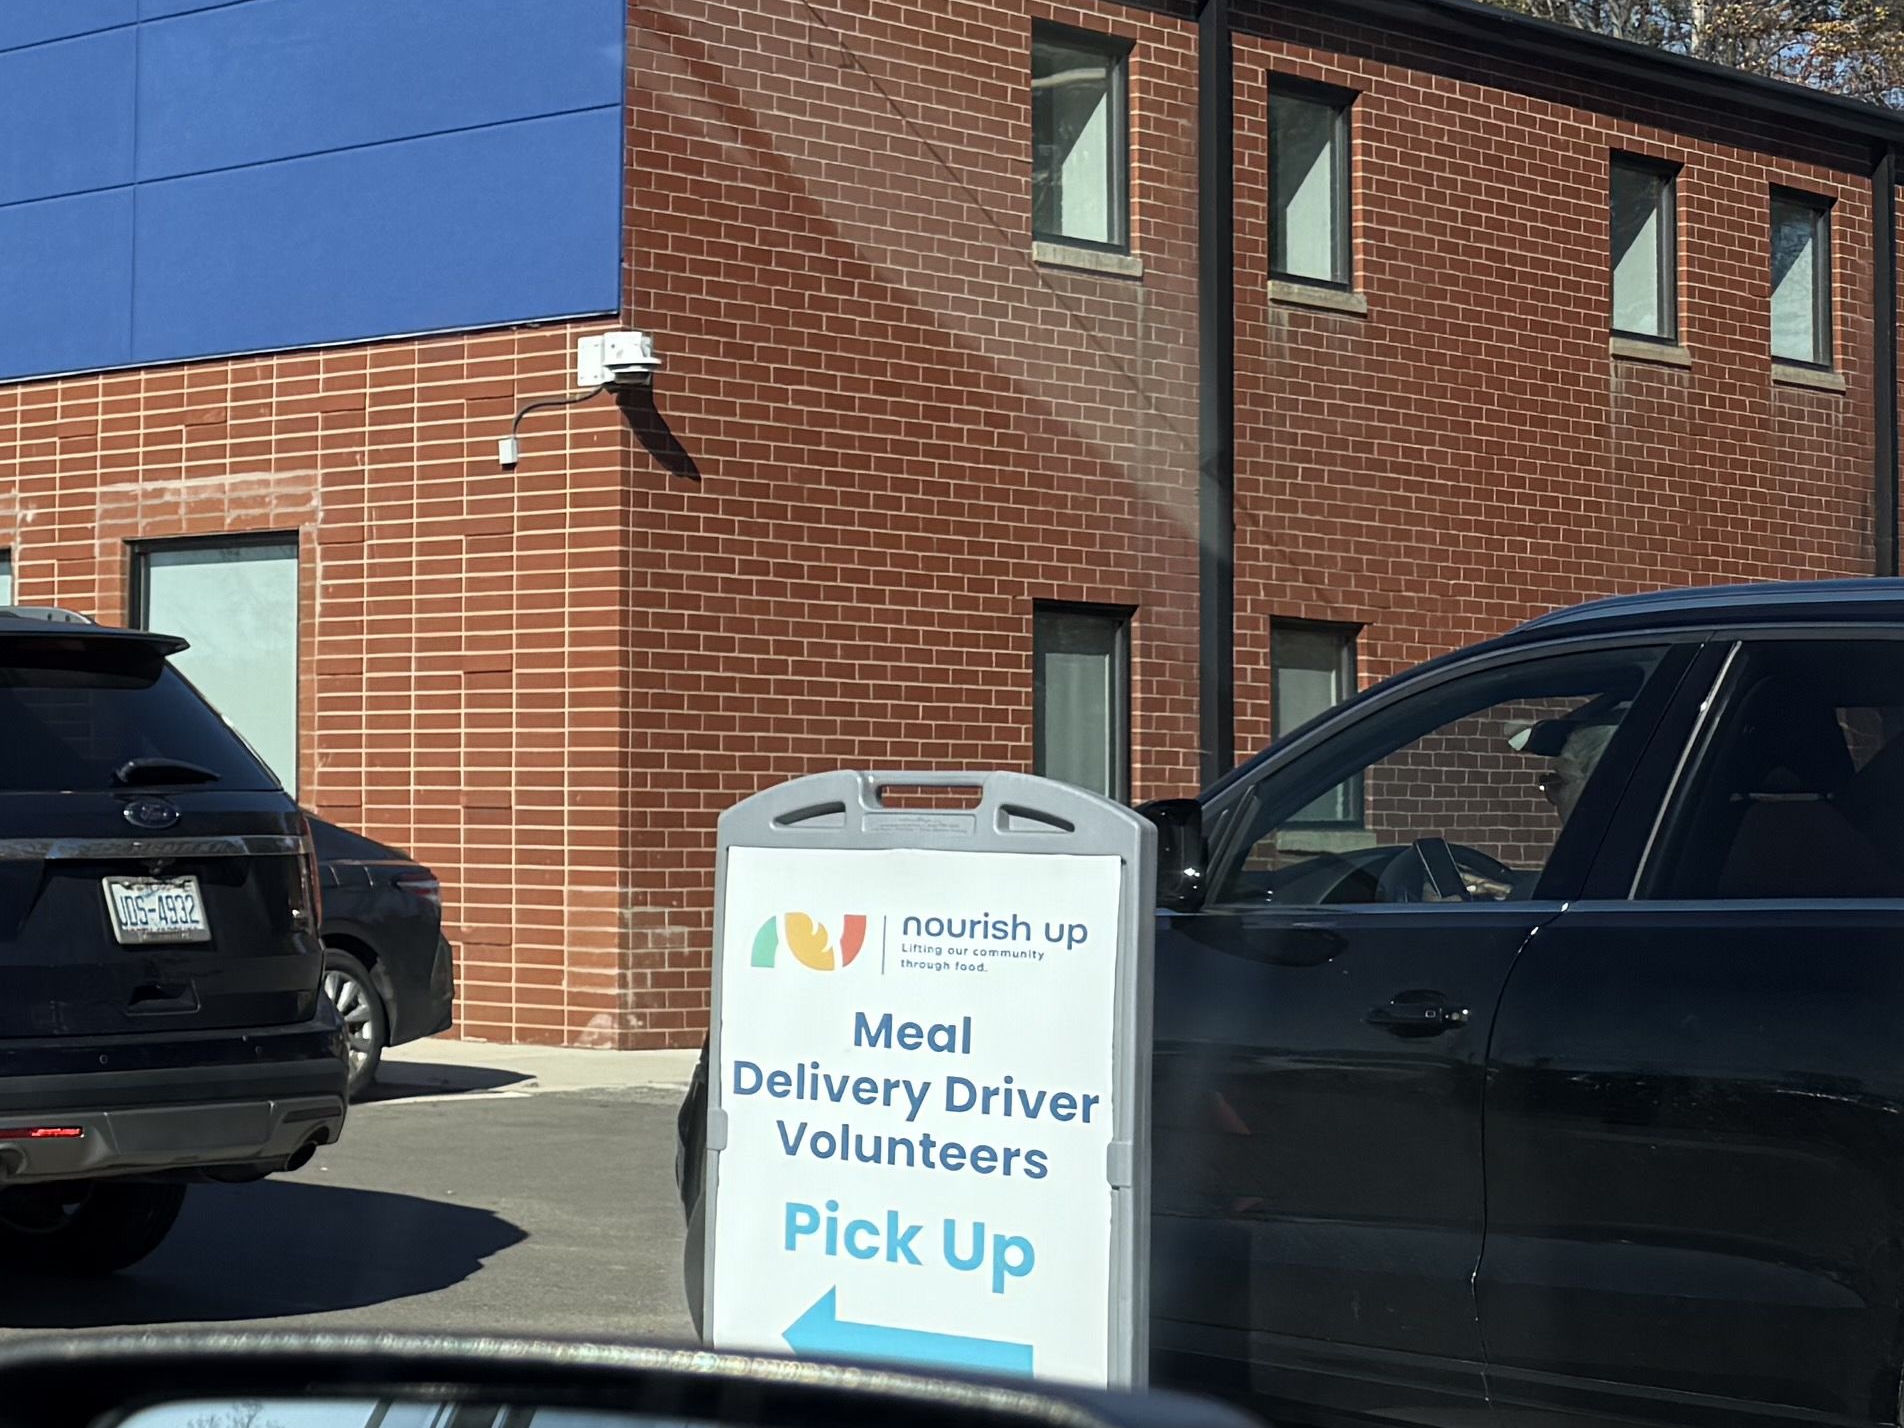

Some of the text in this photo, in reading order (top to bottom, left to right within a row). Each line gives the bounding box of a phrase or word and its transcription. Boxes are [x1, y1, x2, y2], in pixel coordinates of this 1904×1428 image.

[901, 943, 1045, 962] Lifting our community
[902, 911, 1089, 951] nourish up
[900, 959, 988, 973] through food.
[853, 1011, 972, 1055] Meal
[733, 1060, 1101, 1124] Delivery Driver
[776, 1119, 1049, 1180] Volunteers
[784, 1199, 1036, 1295] Pick Up
